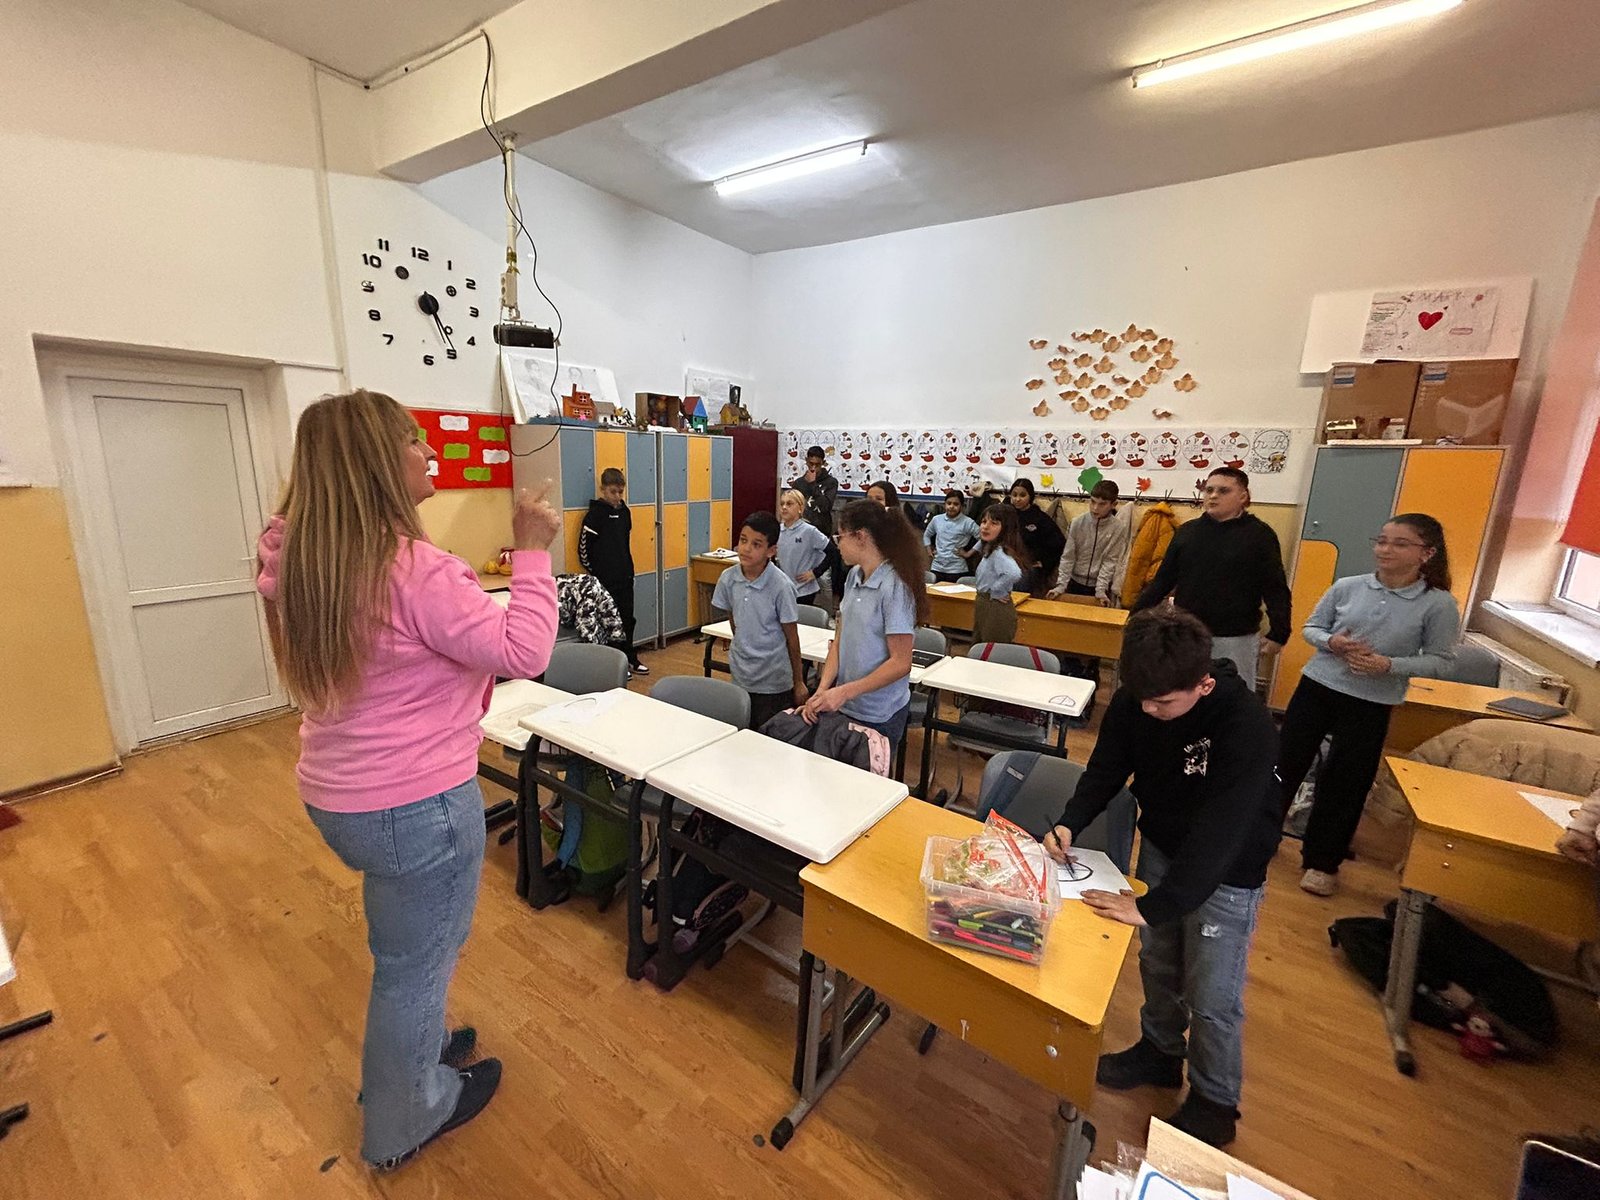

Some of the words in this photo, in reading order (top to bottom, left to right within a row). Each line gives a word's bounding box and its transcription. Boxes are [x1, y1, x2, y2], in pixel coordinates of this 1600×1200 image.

[378, 238, 389, 251] 11
[411, 247, 429, 261] 12
[362, 253, 381, 268] 10
[448, 260, 452, 270] 1
[465, 278, 476, 290] 2
[368, 309, 381, 320] 8
[470, 306, 479, 317] 3
[382, 334, 394, 345] 7
[467, 336, 476, 346] 4
[447, 349, 457, 359] 5
[423, 355, 434, 366] 6
